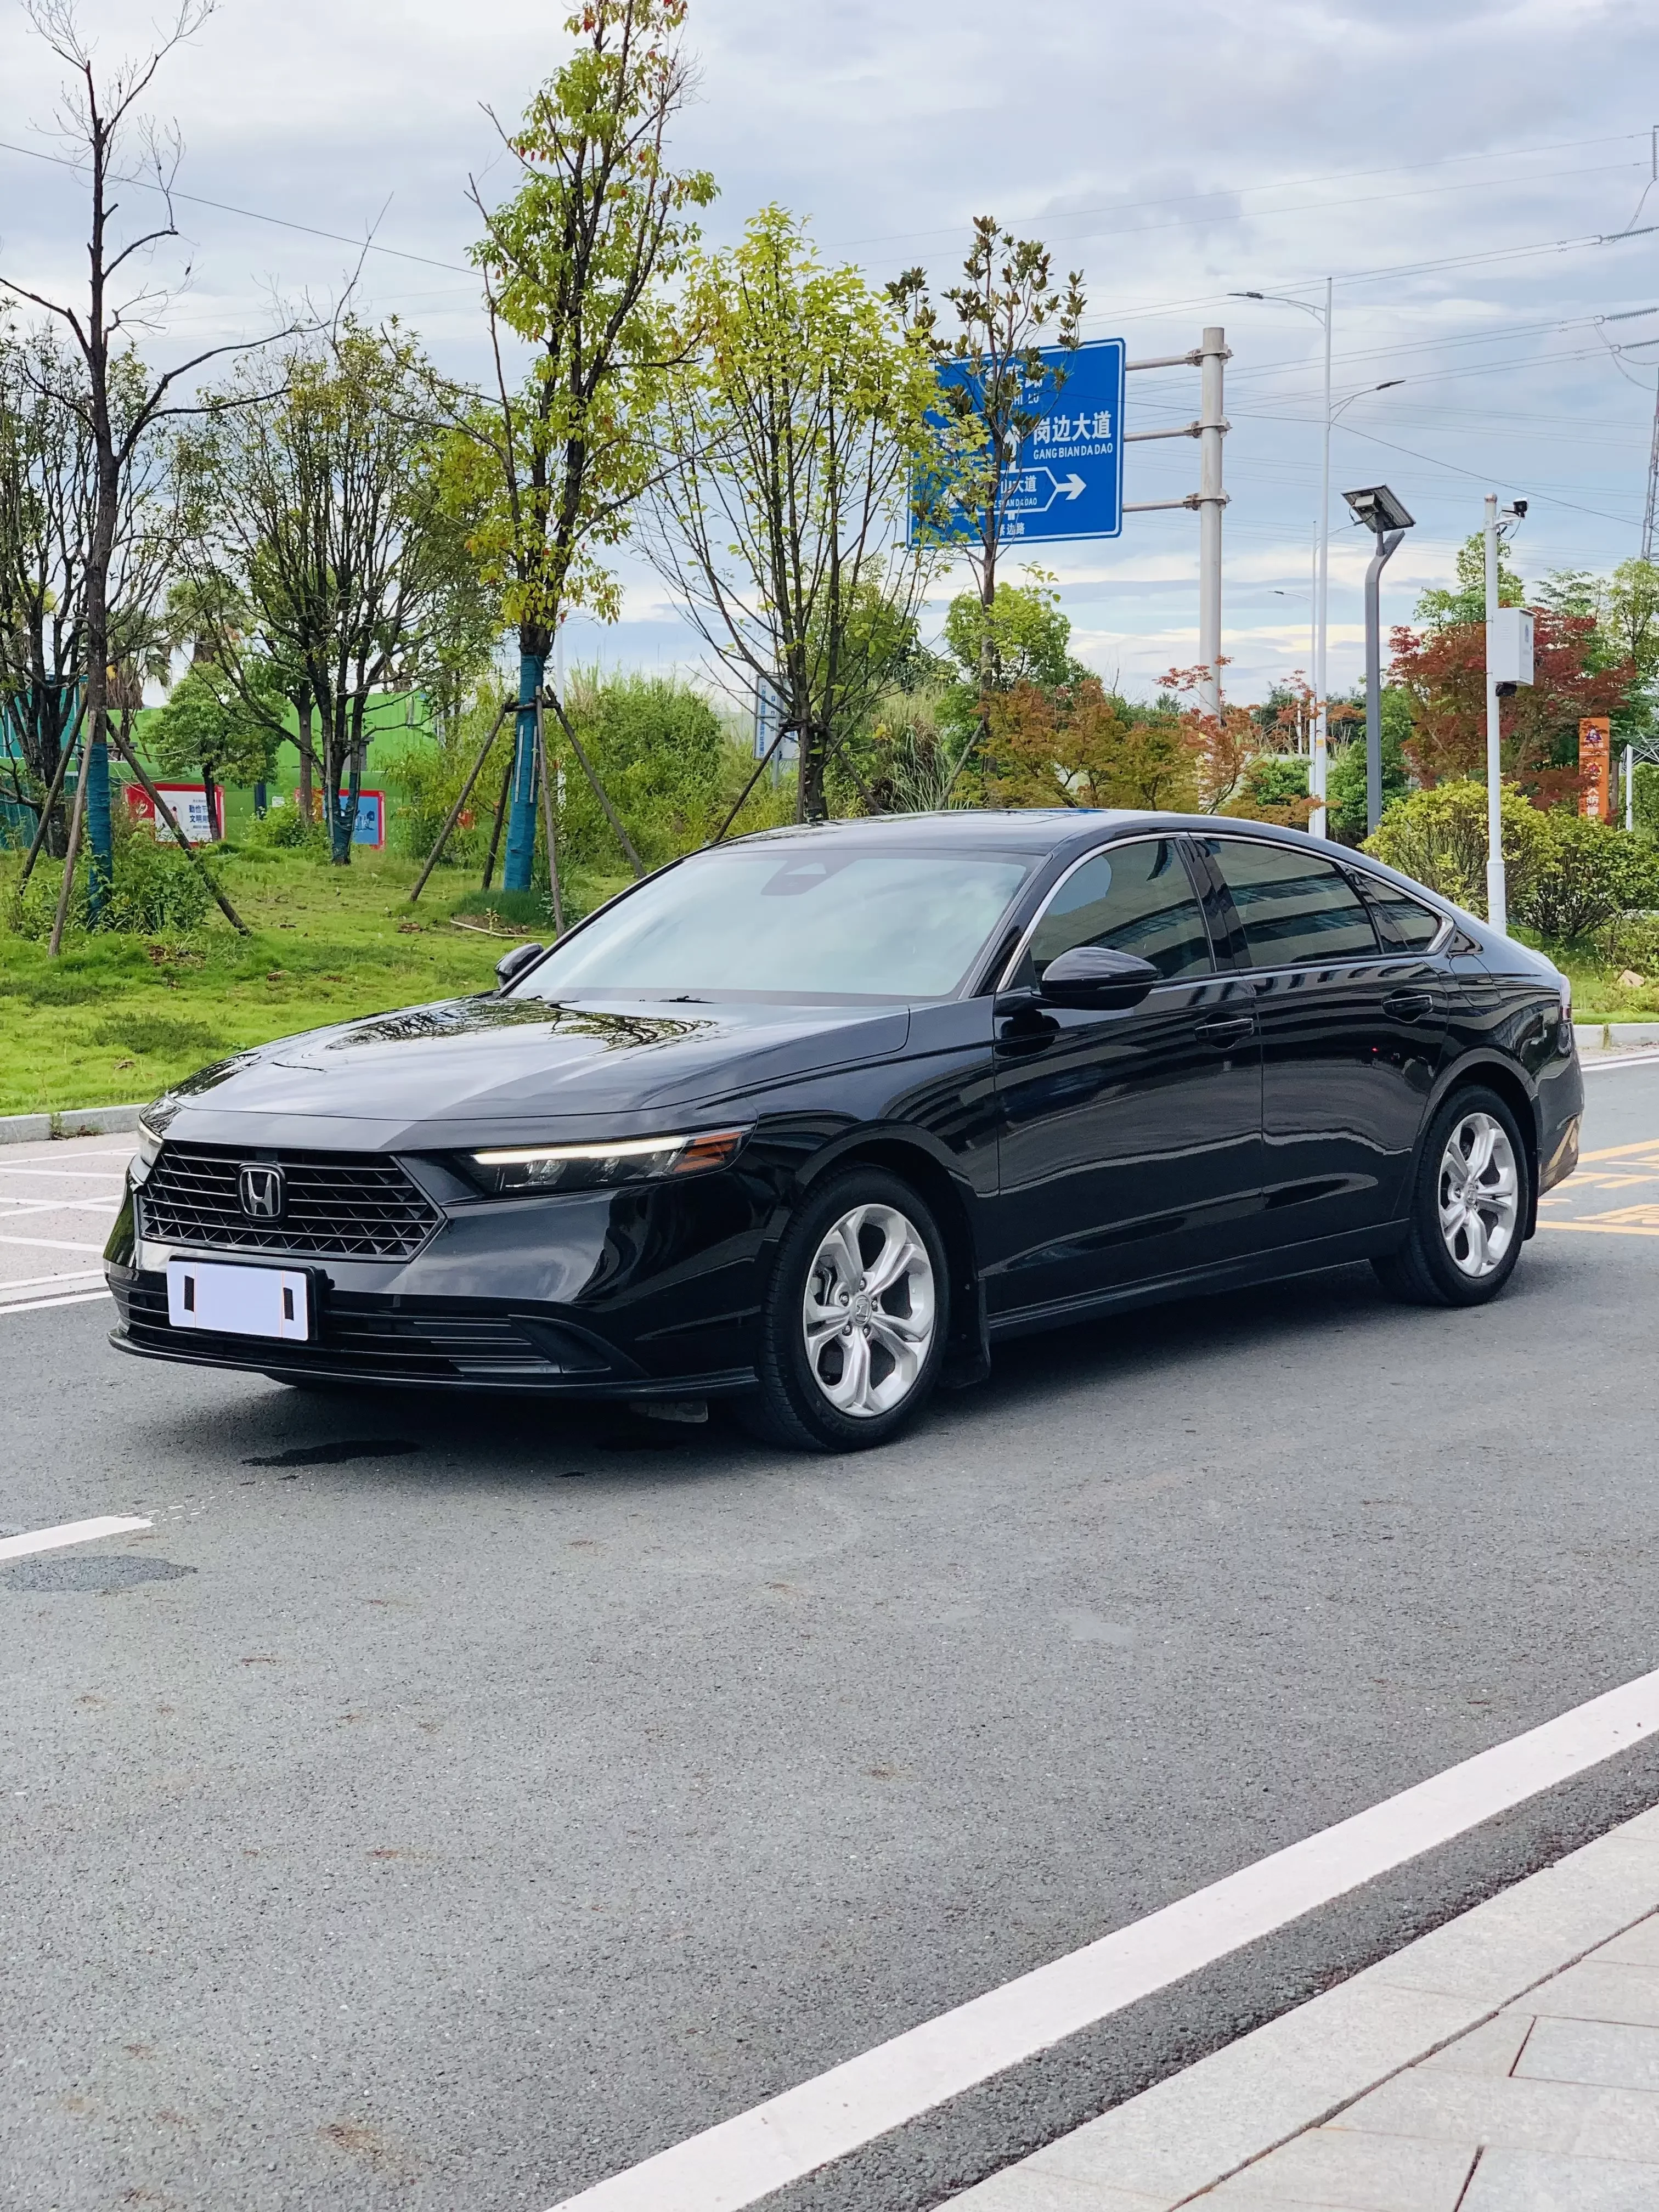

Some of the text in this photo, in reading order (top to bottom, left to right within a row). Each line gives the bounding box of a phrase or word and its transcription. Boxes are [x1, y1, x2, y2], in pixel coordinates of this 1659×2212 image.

[1033, 410, 1112, 445] 岗边大道
[1033, 442, 1113, 460] GANG BIAN DA DAO
[1025, 496, 1037, 506] DAO
[189, 805, 208, 813] 勤俭节
